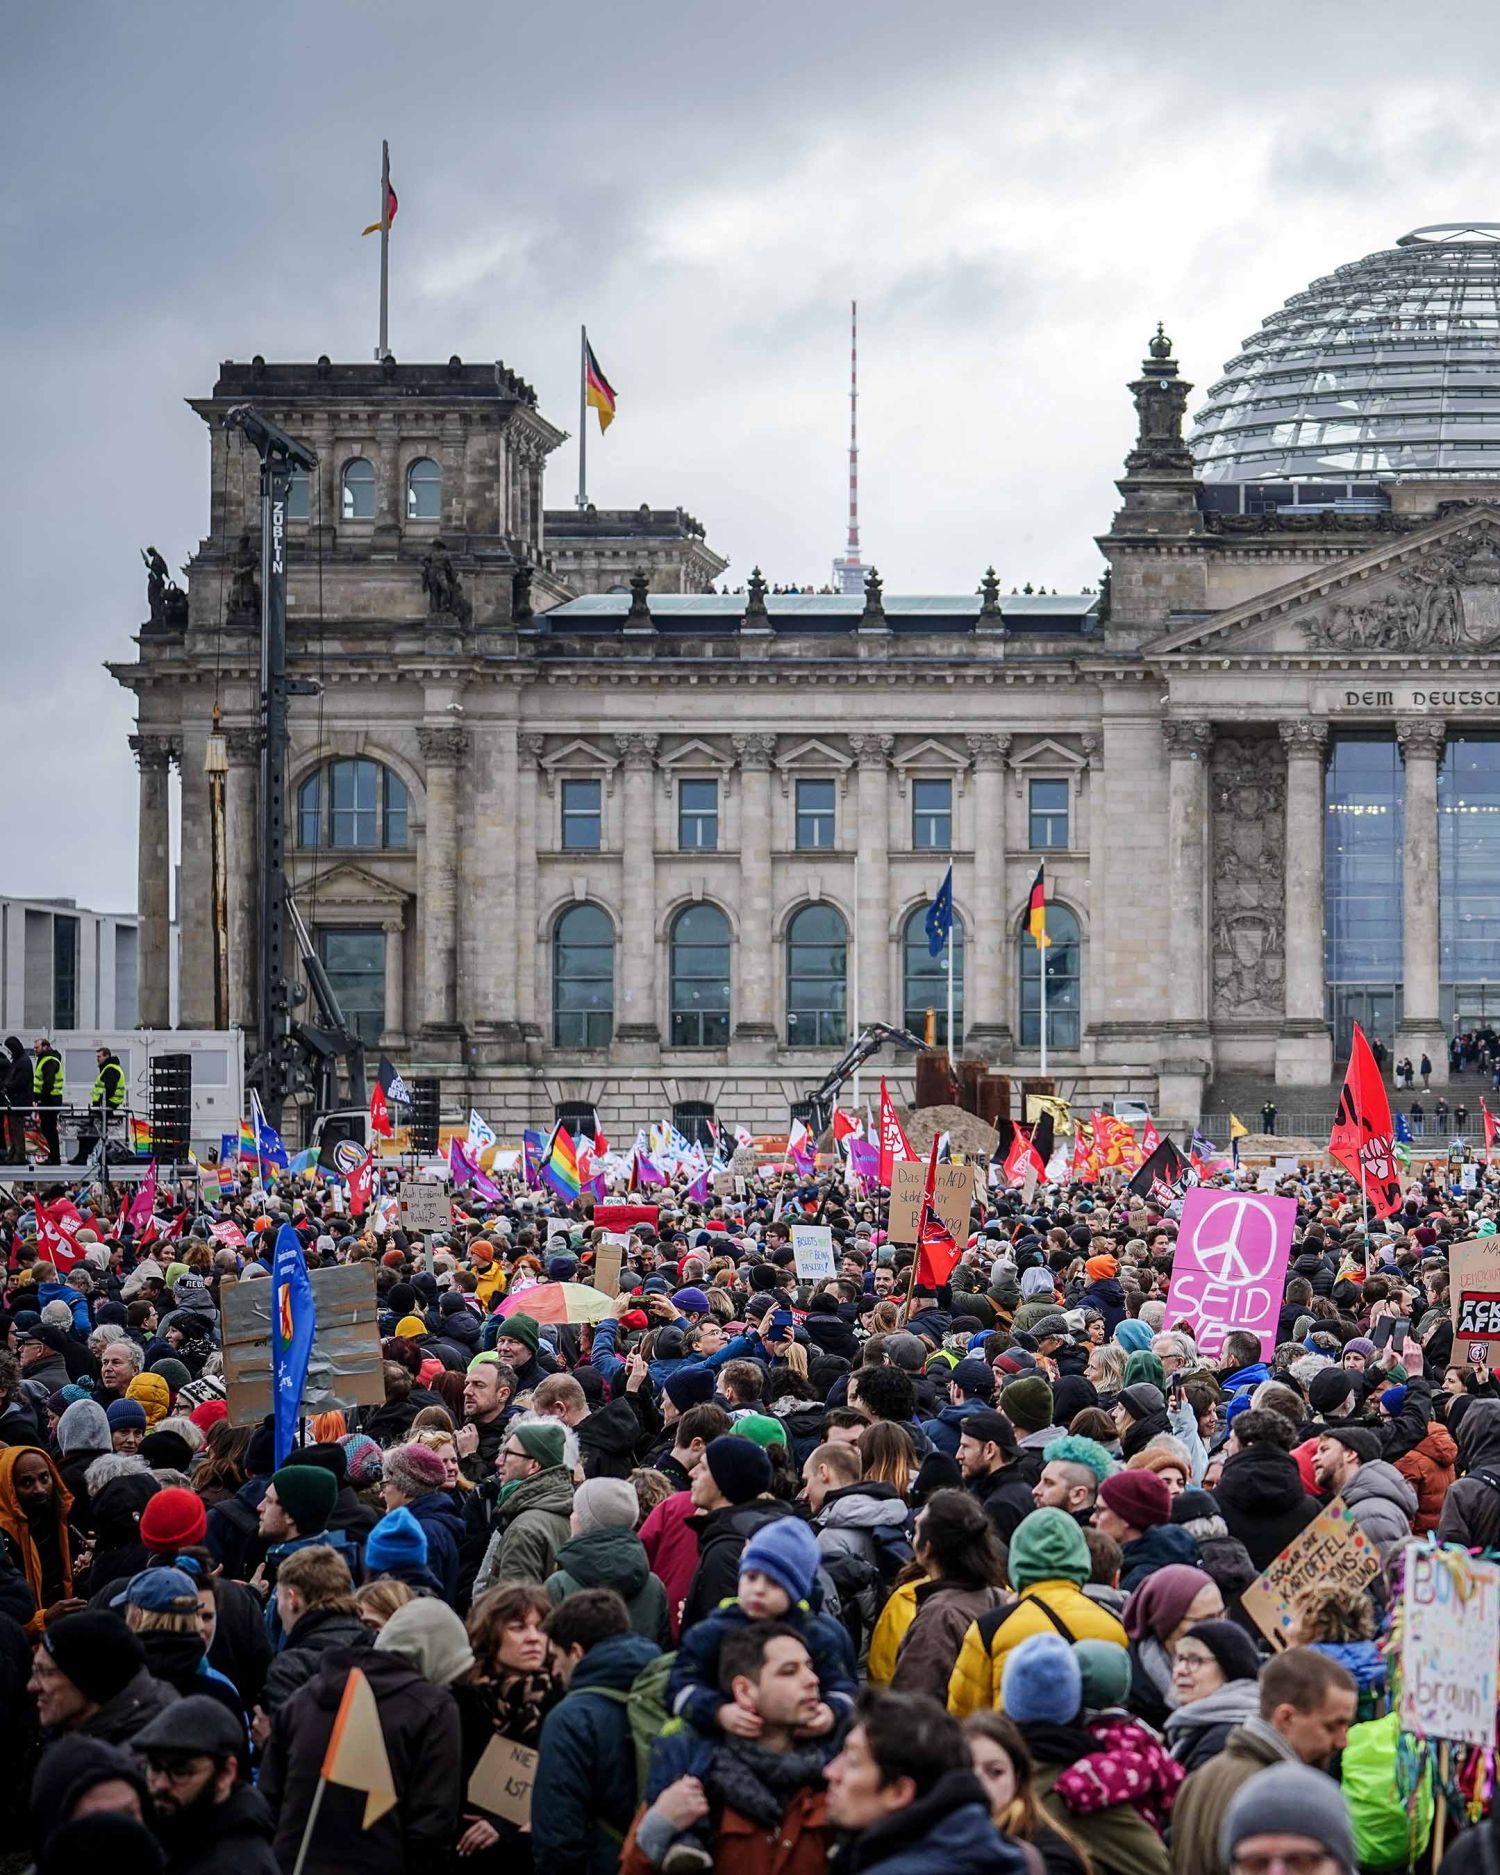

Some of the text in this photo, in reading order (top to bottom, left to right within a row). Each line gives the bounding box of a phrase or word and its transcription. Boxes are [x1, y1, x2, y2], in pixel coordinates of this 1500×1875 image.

[1345, 690, 1393, 706] DEM
[898, 1168, 919, 1184] Das
[946, 1170, 967, 1189] AfD
[900, 1190, 922, 1203] steht
[1169, 1275, 1271, 1323] SEID
[1270, 1531, 1319, 1586] SOGAR DIE
[1279, 1536, 1346, 1604] KARTOFFEL
[510, 1746, 537, 1769] NIE
[503, 1775, 533, 1801] IST
